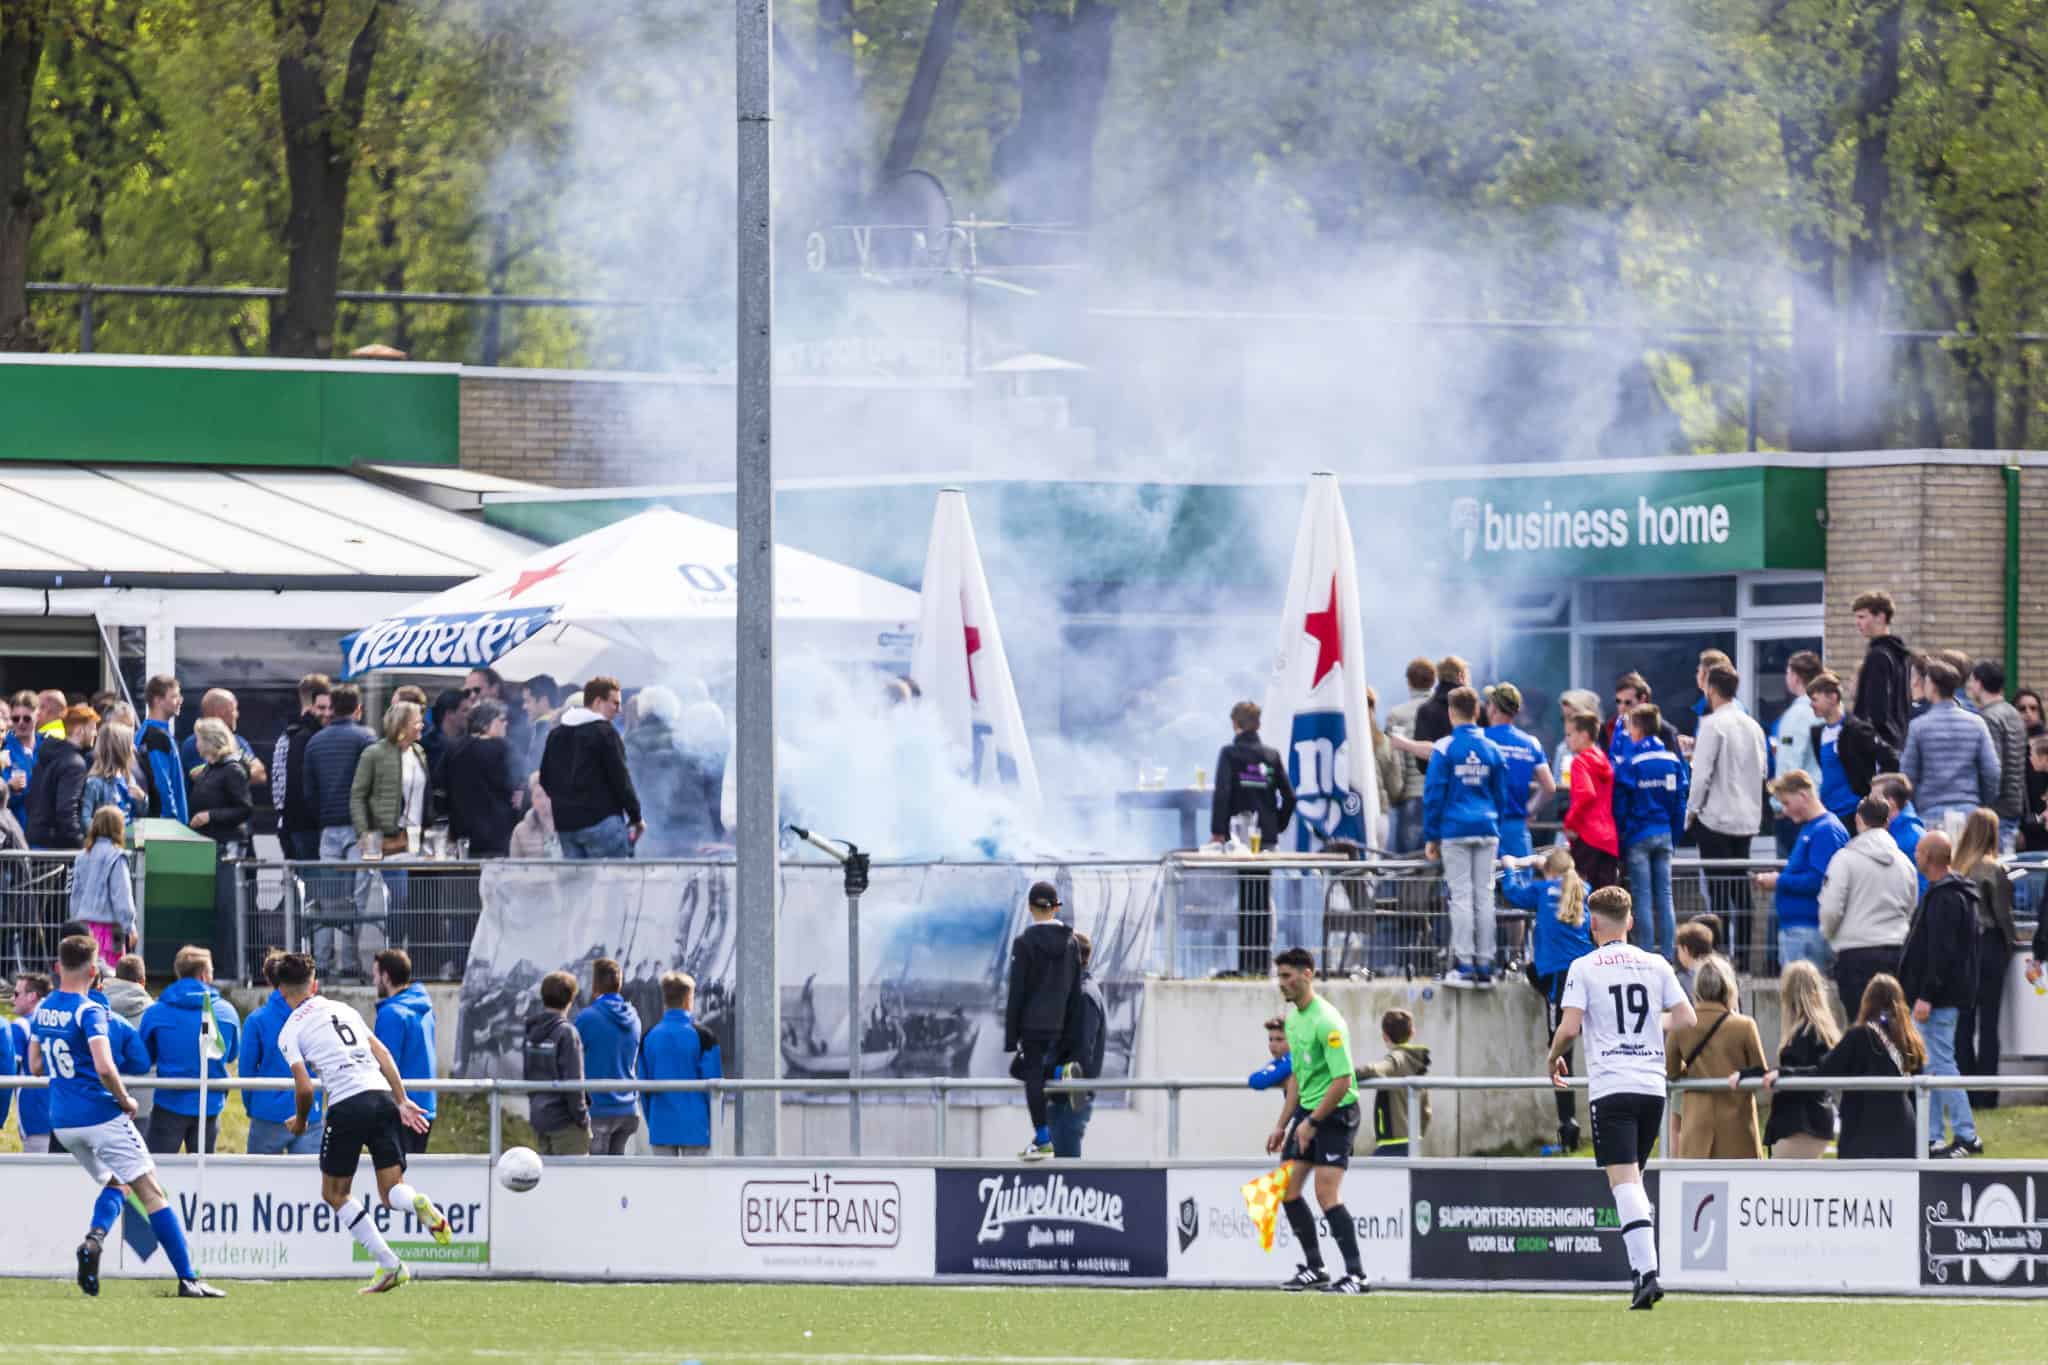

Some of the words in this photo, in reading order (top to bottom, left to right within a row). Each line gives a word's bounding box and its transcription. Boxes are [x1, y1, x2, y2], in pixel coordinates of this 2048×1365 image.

[1484, 500, 1628, 551] business
[1638, 495, 1730, 546] home
[1608, 983, 1649, 1034] 19
[331, 1014, 357, 1046] 6
[41, 1036, 75, 1079] 16
[179, 1191, 238, 1233] Van
[746, 1196, 897, 1234] BIKETRANS
[976, 1173, 1125, 1244] Zuivelhoeve
[1438, 1206, 1595, 1228] SUPPORTERSVERENIGING
[1738, 1196, 1893, 1229] SCHUITEMAN
[1467, 1236, 1496, 1252] VOOR
[1497, 1236, 1515, 1253] ELK
[1554, 1236, 1573, 1253] WIT
[1574, 1236, 1602, 1253] DOEL
